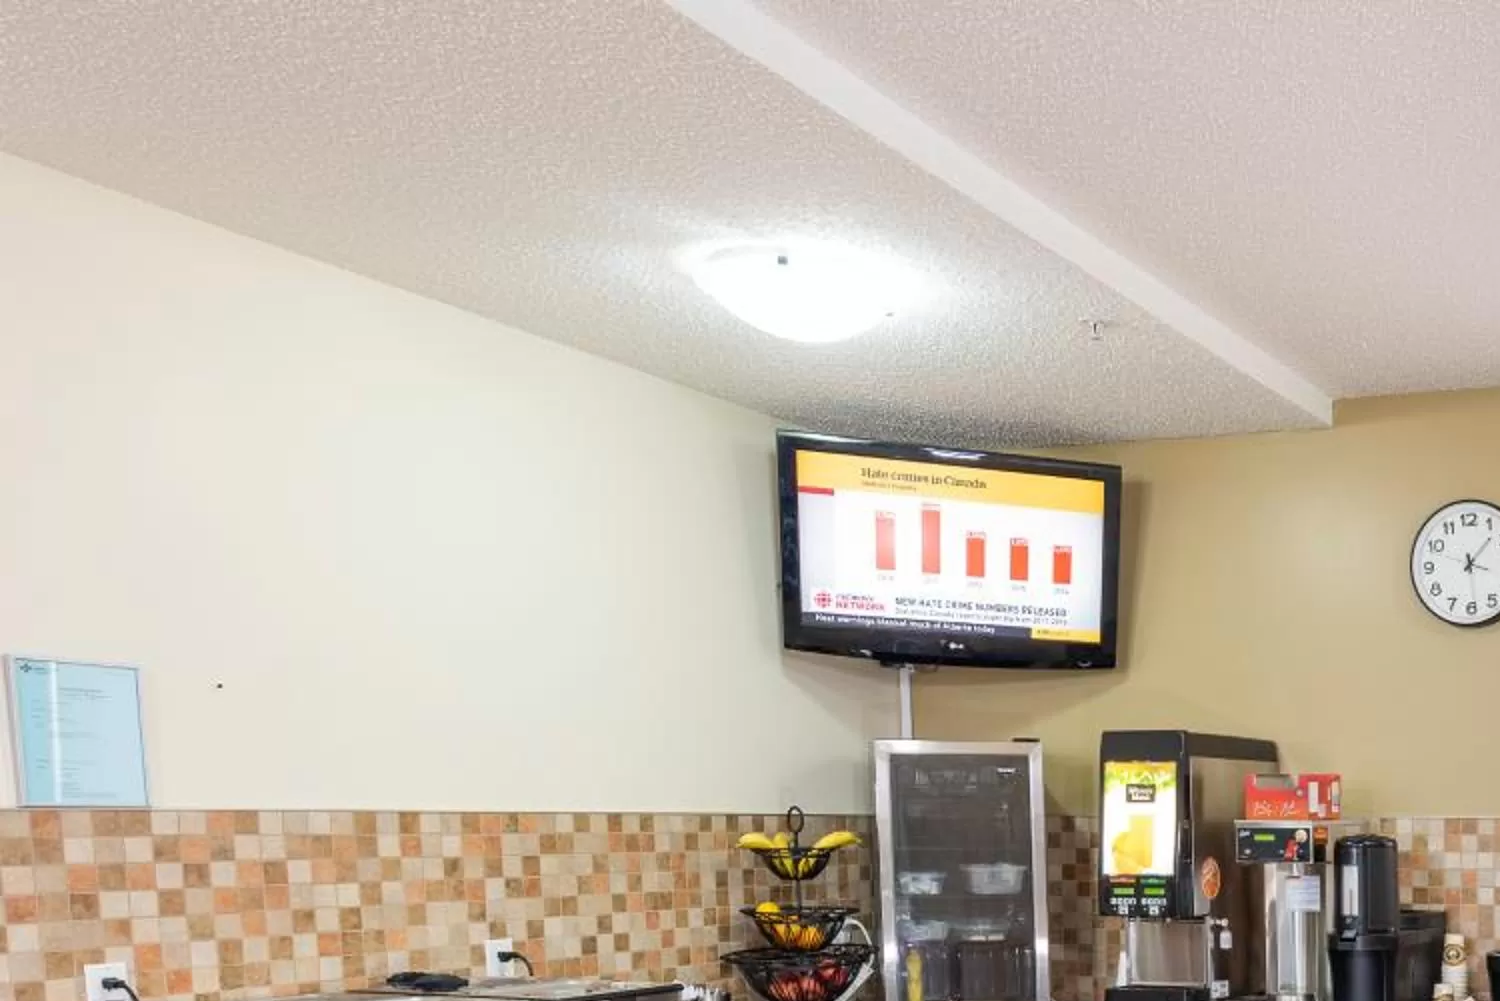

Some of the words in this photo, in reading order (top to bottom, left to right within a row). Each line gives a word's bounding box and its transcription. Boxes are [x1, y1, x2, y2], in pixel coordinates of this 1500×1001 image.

[931, 475, 942, 485] in
[1460, 512, 1478, 527] 12
[1486, 517, 1494, 531] 1
[1443, 520, 1456, 535] 11
[1427, 539, 1445, 553] 10
[1423, 561, 1435, 575] 9
[1429, 581, 1443, 597] 8
[1446, 597, 1458, 612] 7
[1486, 593, 1499, 608] 5
[1465, 601, 1478, 615] 6
